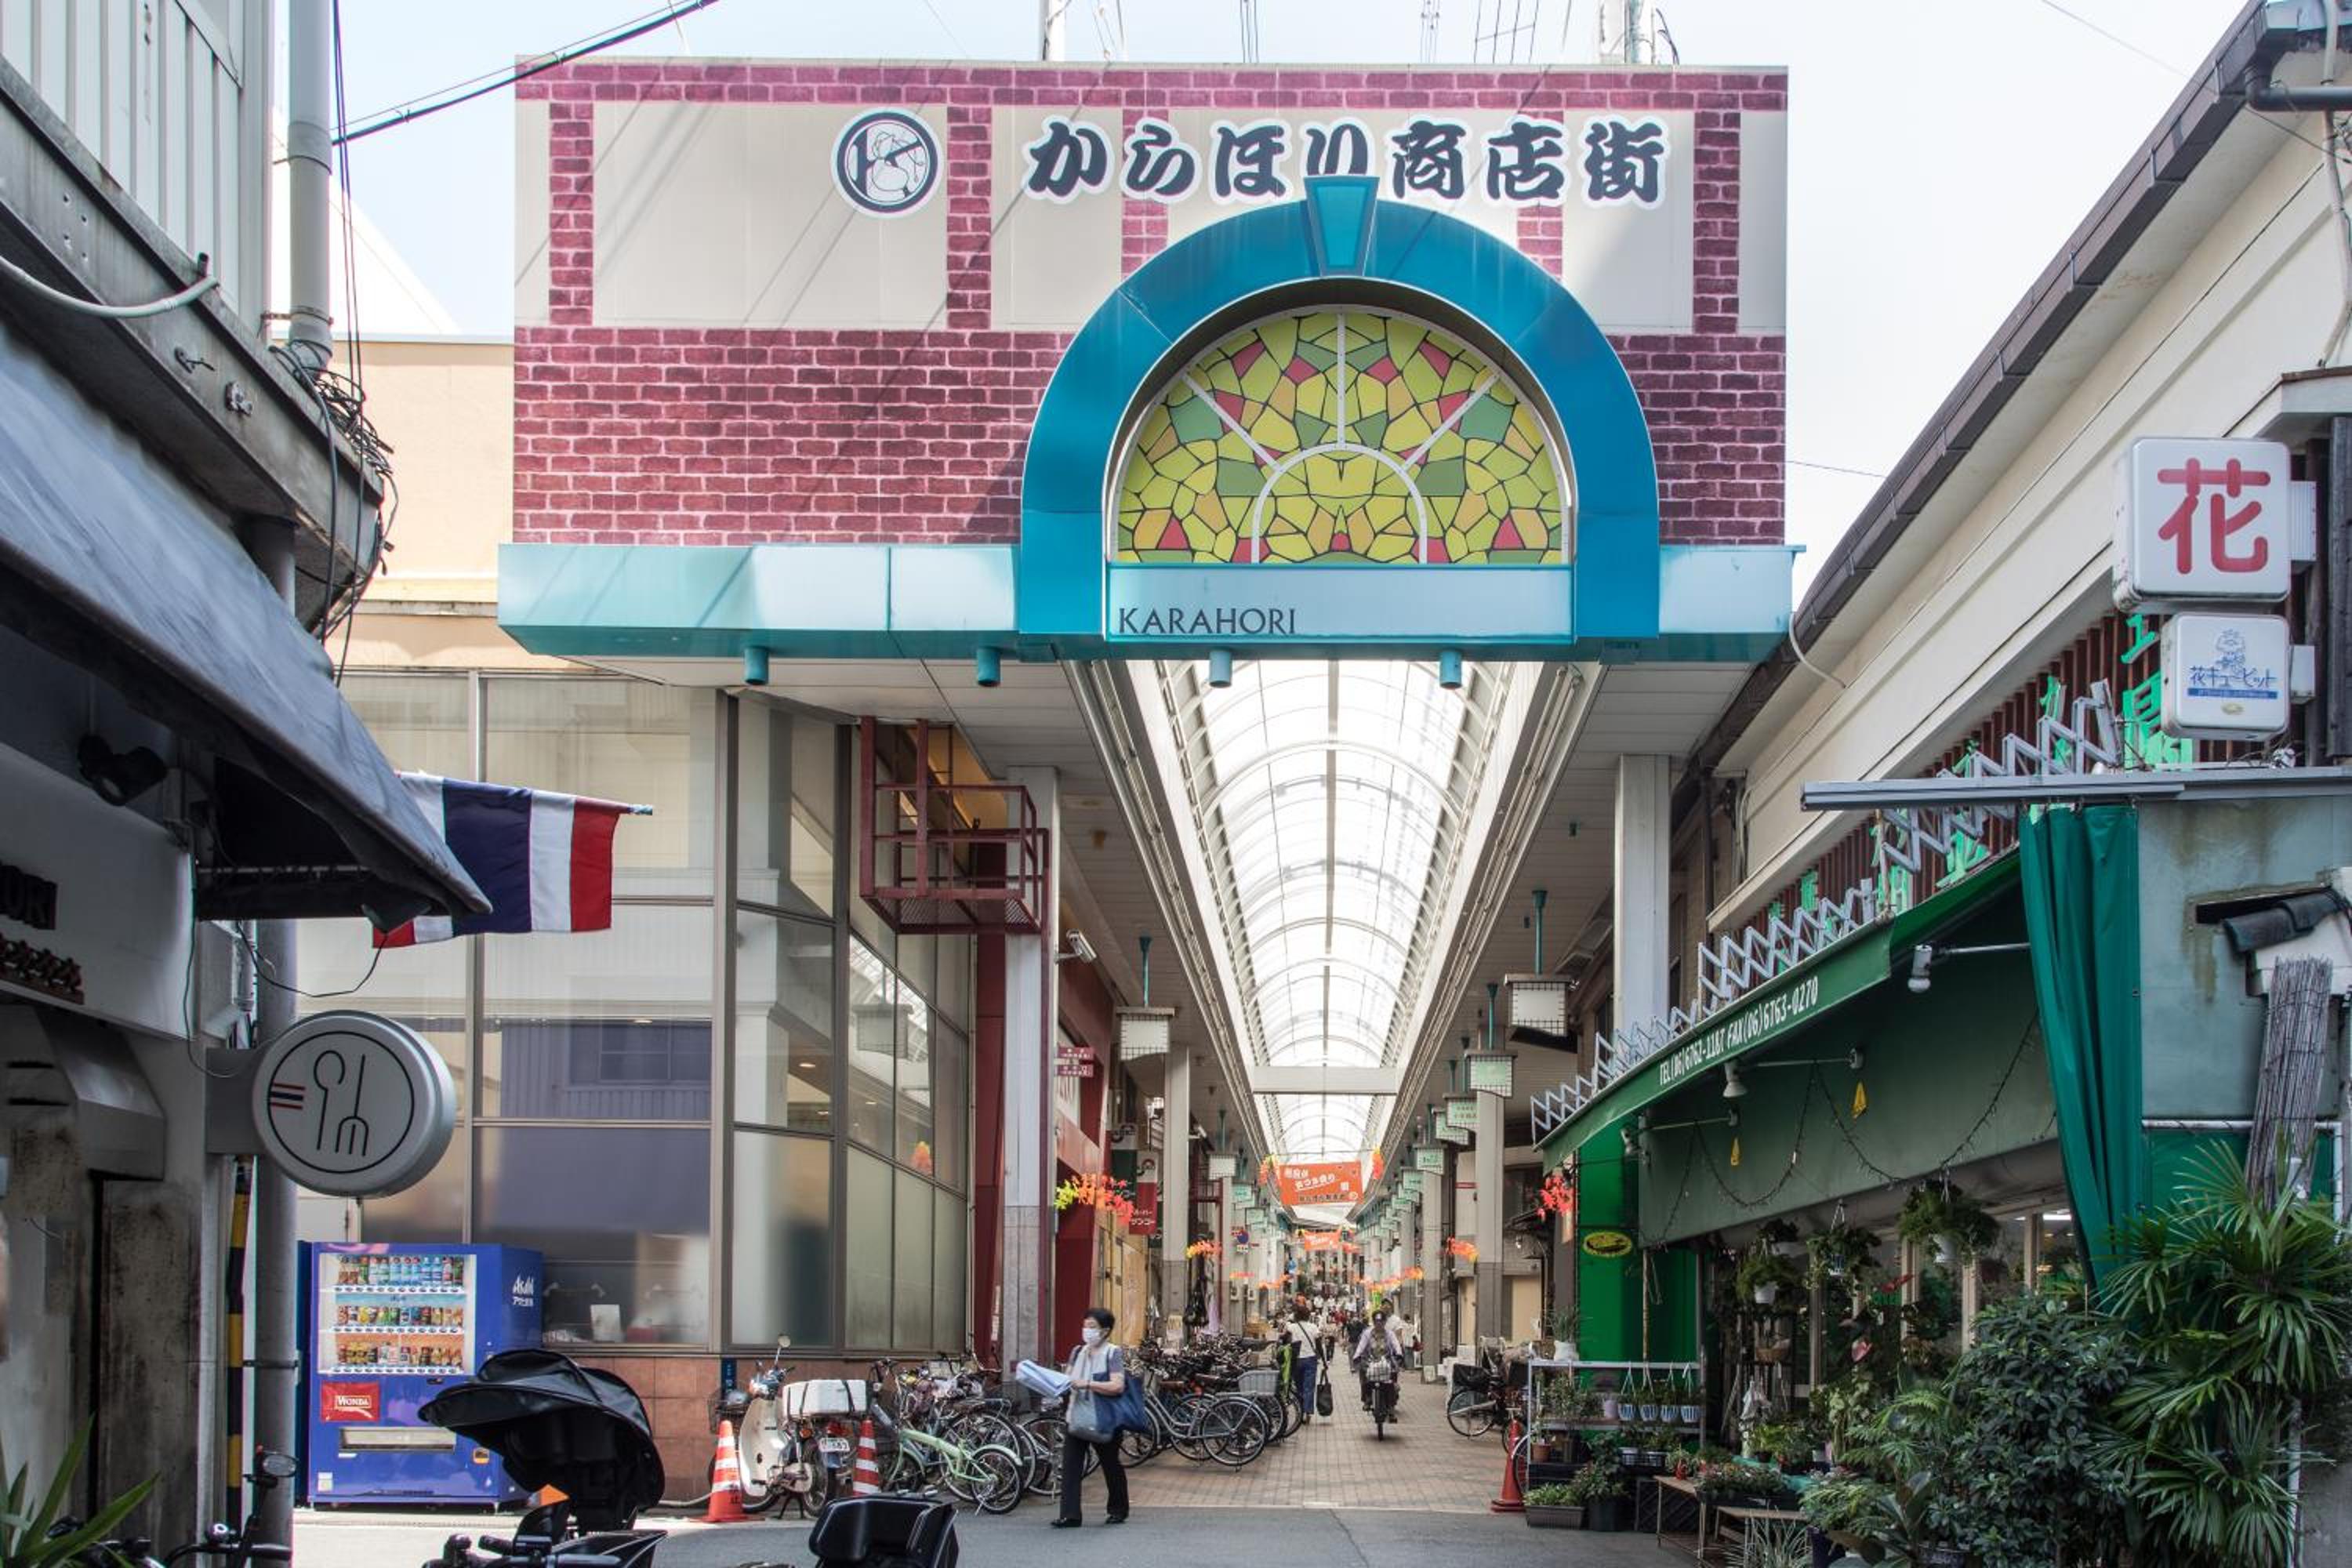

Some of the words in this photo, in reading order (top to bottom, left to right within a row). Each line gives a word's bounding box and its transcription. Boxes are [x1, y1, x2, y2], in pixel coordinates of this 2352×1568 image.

[1028, 120, 1665, 203] からほり商店街
[2157, 456, 2270, 575] 花
[1119, 608, 1296, 634] KARAHORI
[337, 1396, 369, 1406] WONDA
